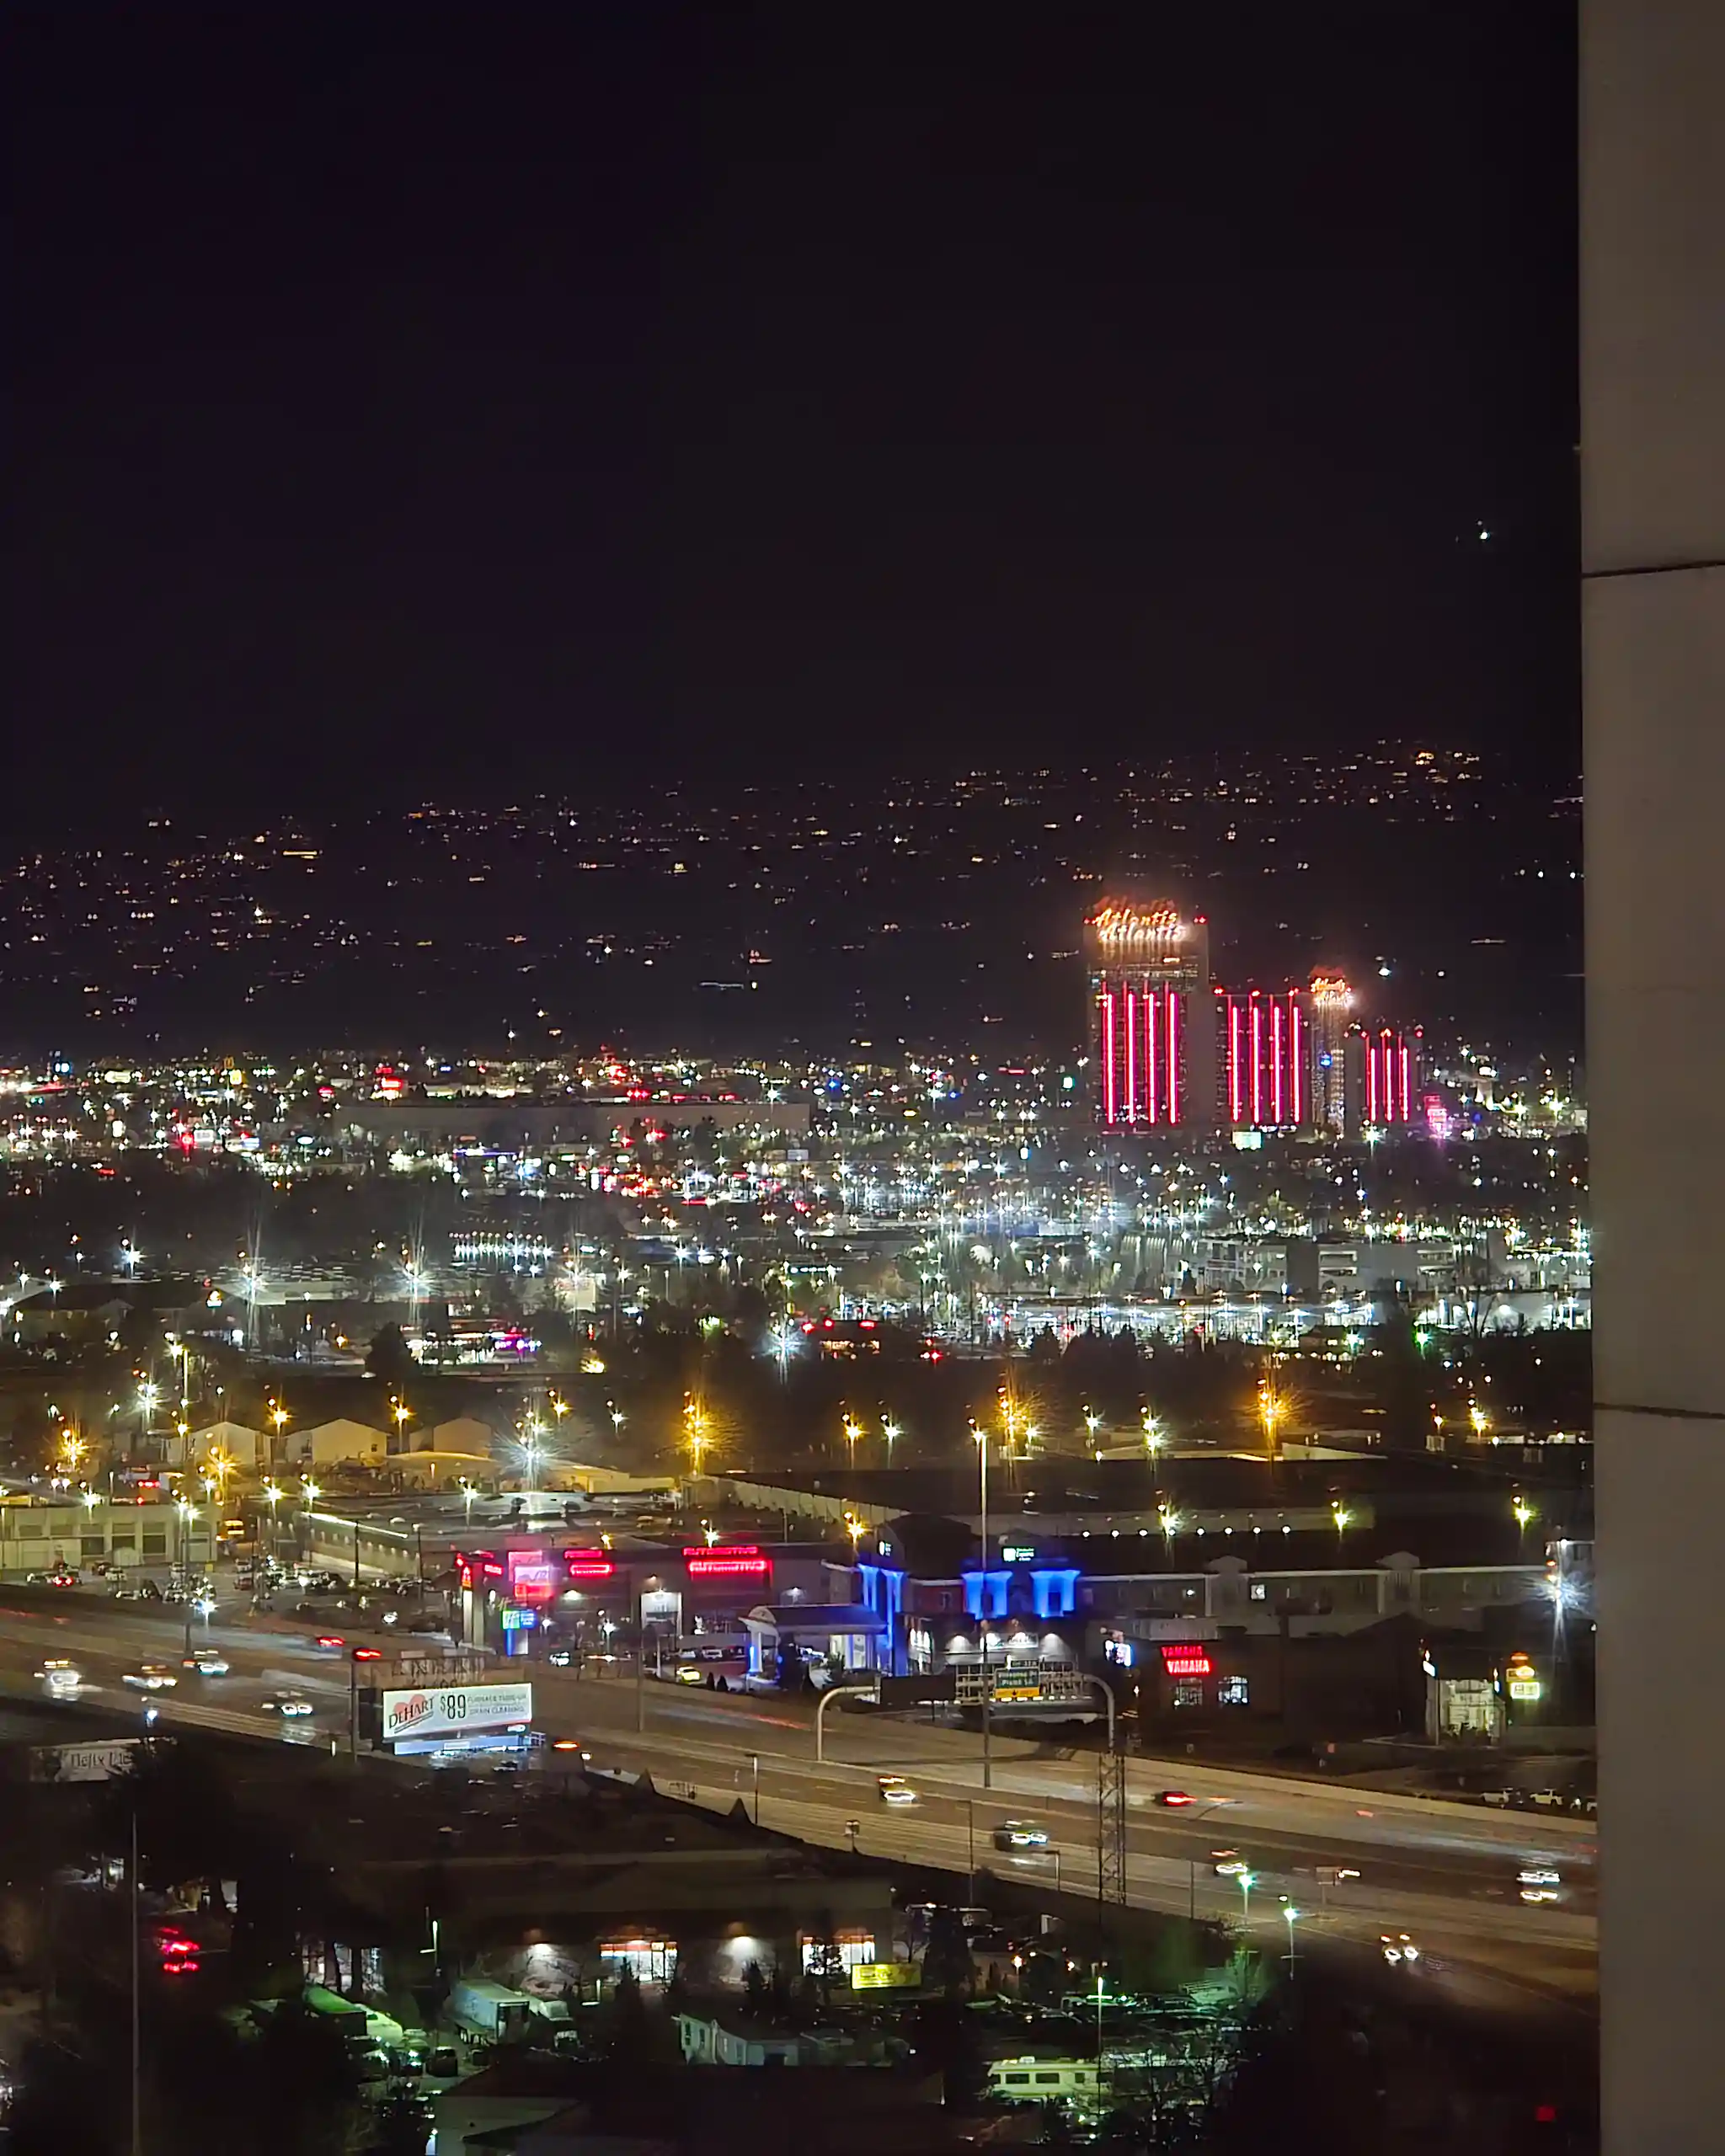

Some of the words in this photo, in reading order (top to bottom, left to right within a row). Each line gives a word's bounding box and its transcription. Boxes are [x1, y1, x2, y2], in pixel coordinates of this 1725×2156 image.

[1095, 908, 1178, 926] Atlantis
[1099, 922, 1187, 942] Atlantis
[1167, 1659, 1210, 1673] YAMAHA
[441, 1694, 467, 1720] $89
